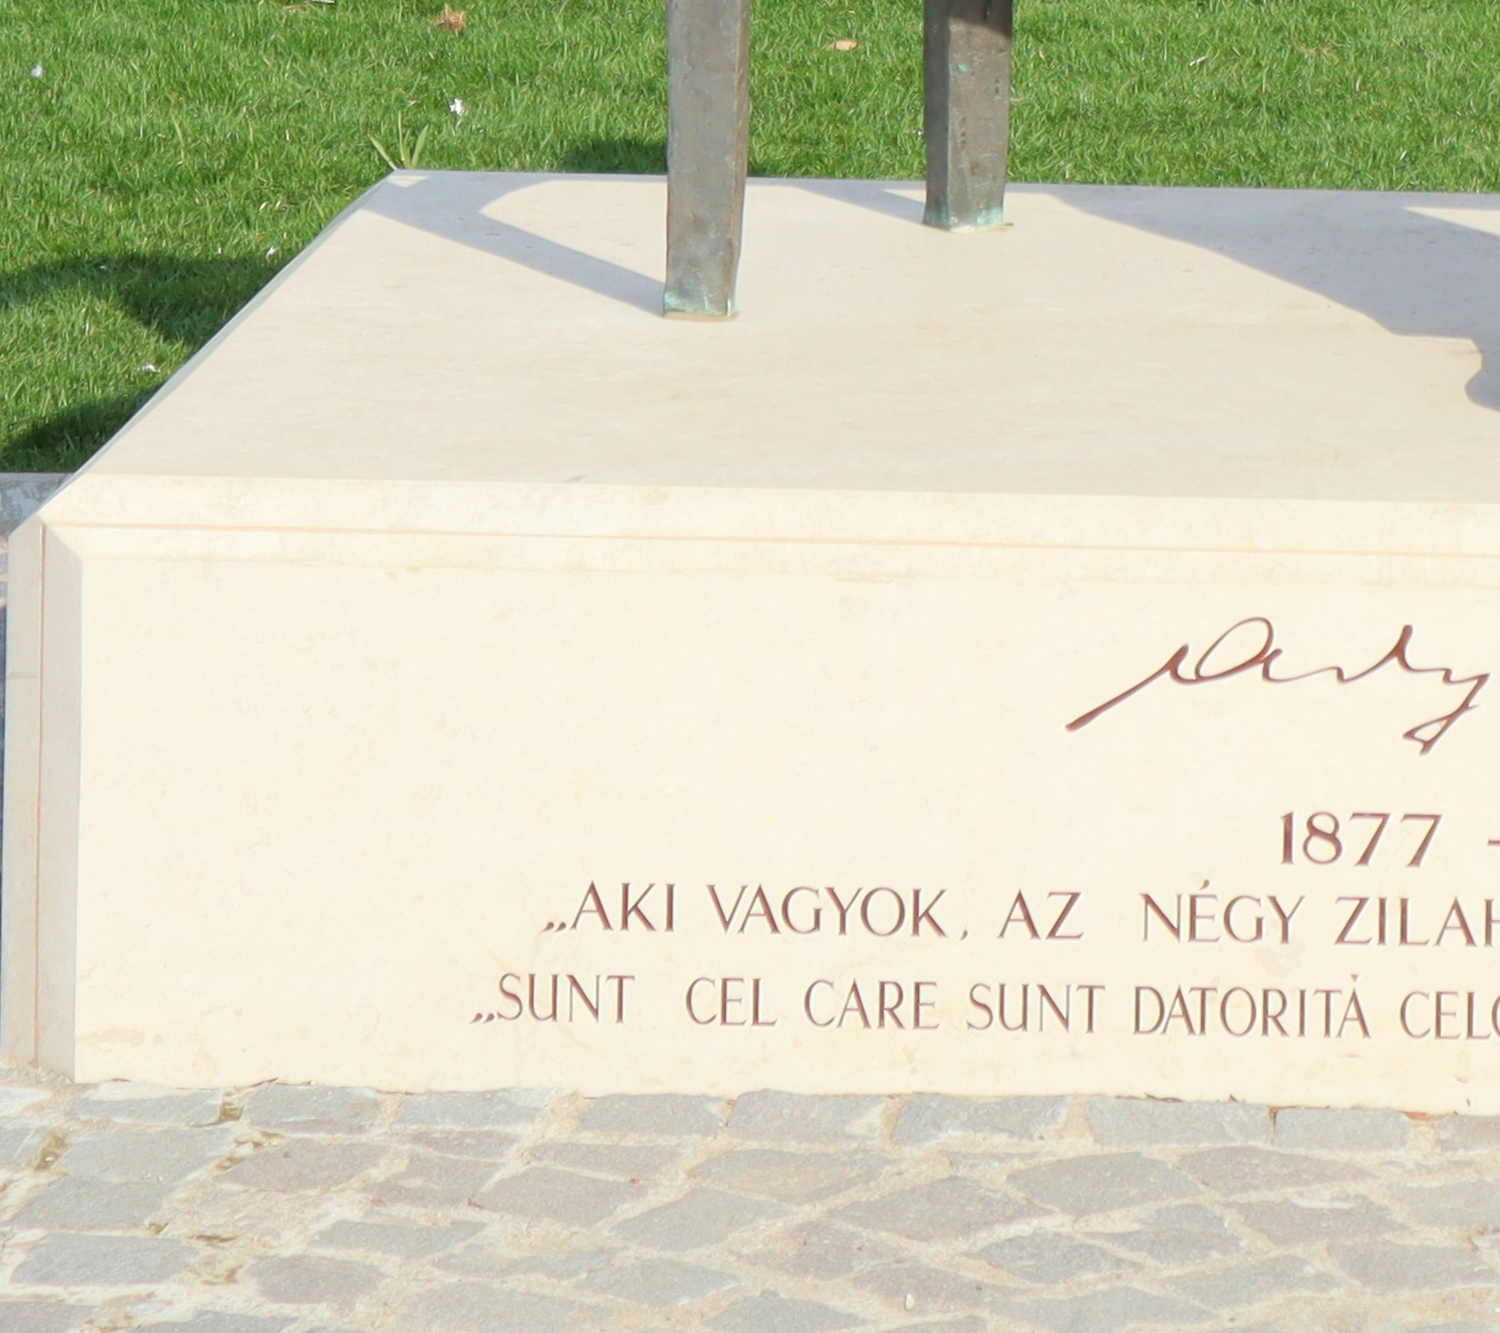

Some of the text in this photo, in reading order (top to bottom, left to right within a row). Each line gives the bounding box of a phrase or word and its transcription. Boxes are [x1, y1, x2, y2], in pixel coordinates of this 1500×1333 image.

[1280, 811, 1443, 868] 1877
[706, 883, 969, 941] VAGYOK,
[997, 889, 1084, 940] AZ
[1140, 879, 1305, 945] NÉGY
[685, 976, 778, 1027] CEL
[803, 978, 940, 1030] CARE
[966, 982, 1106, 1034] SUNT
